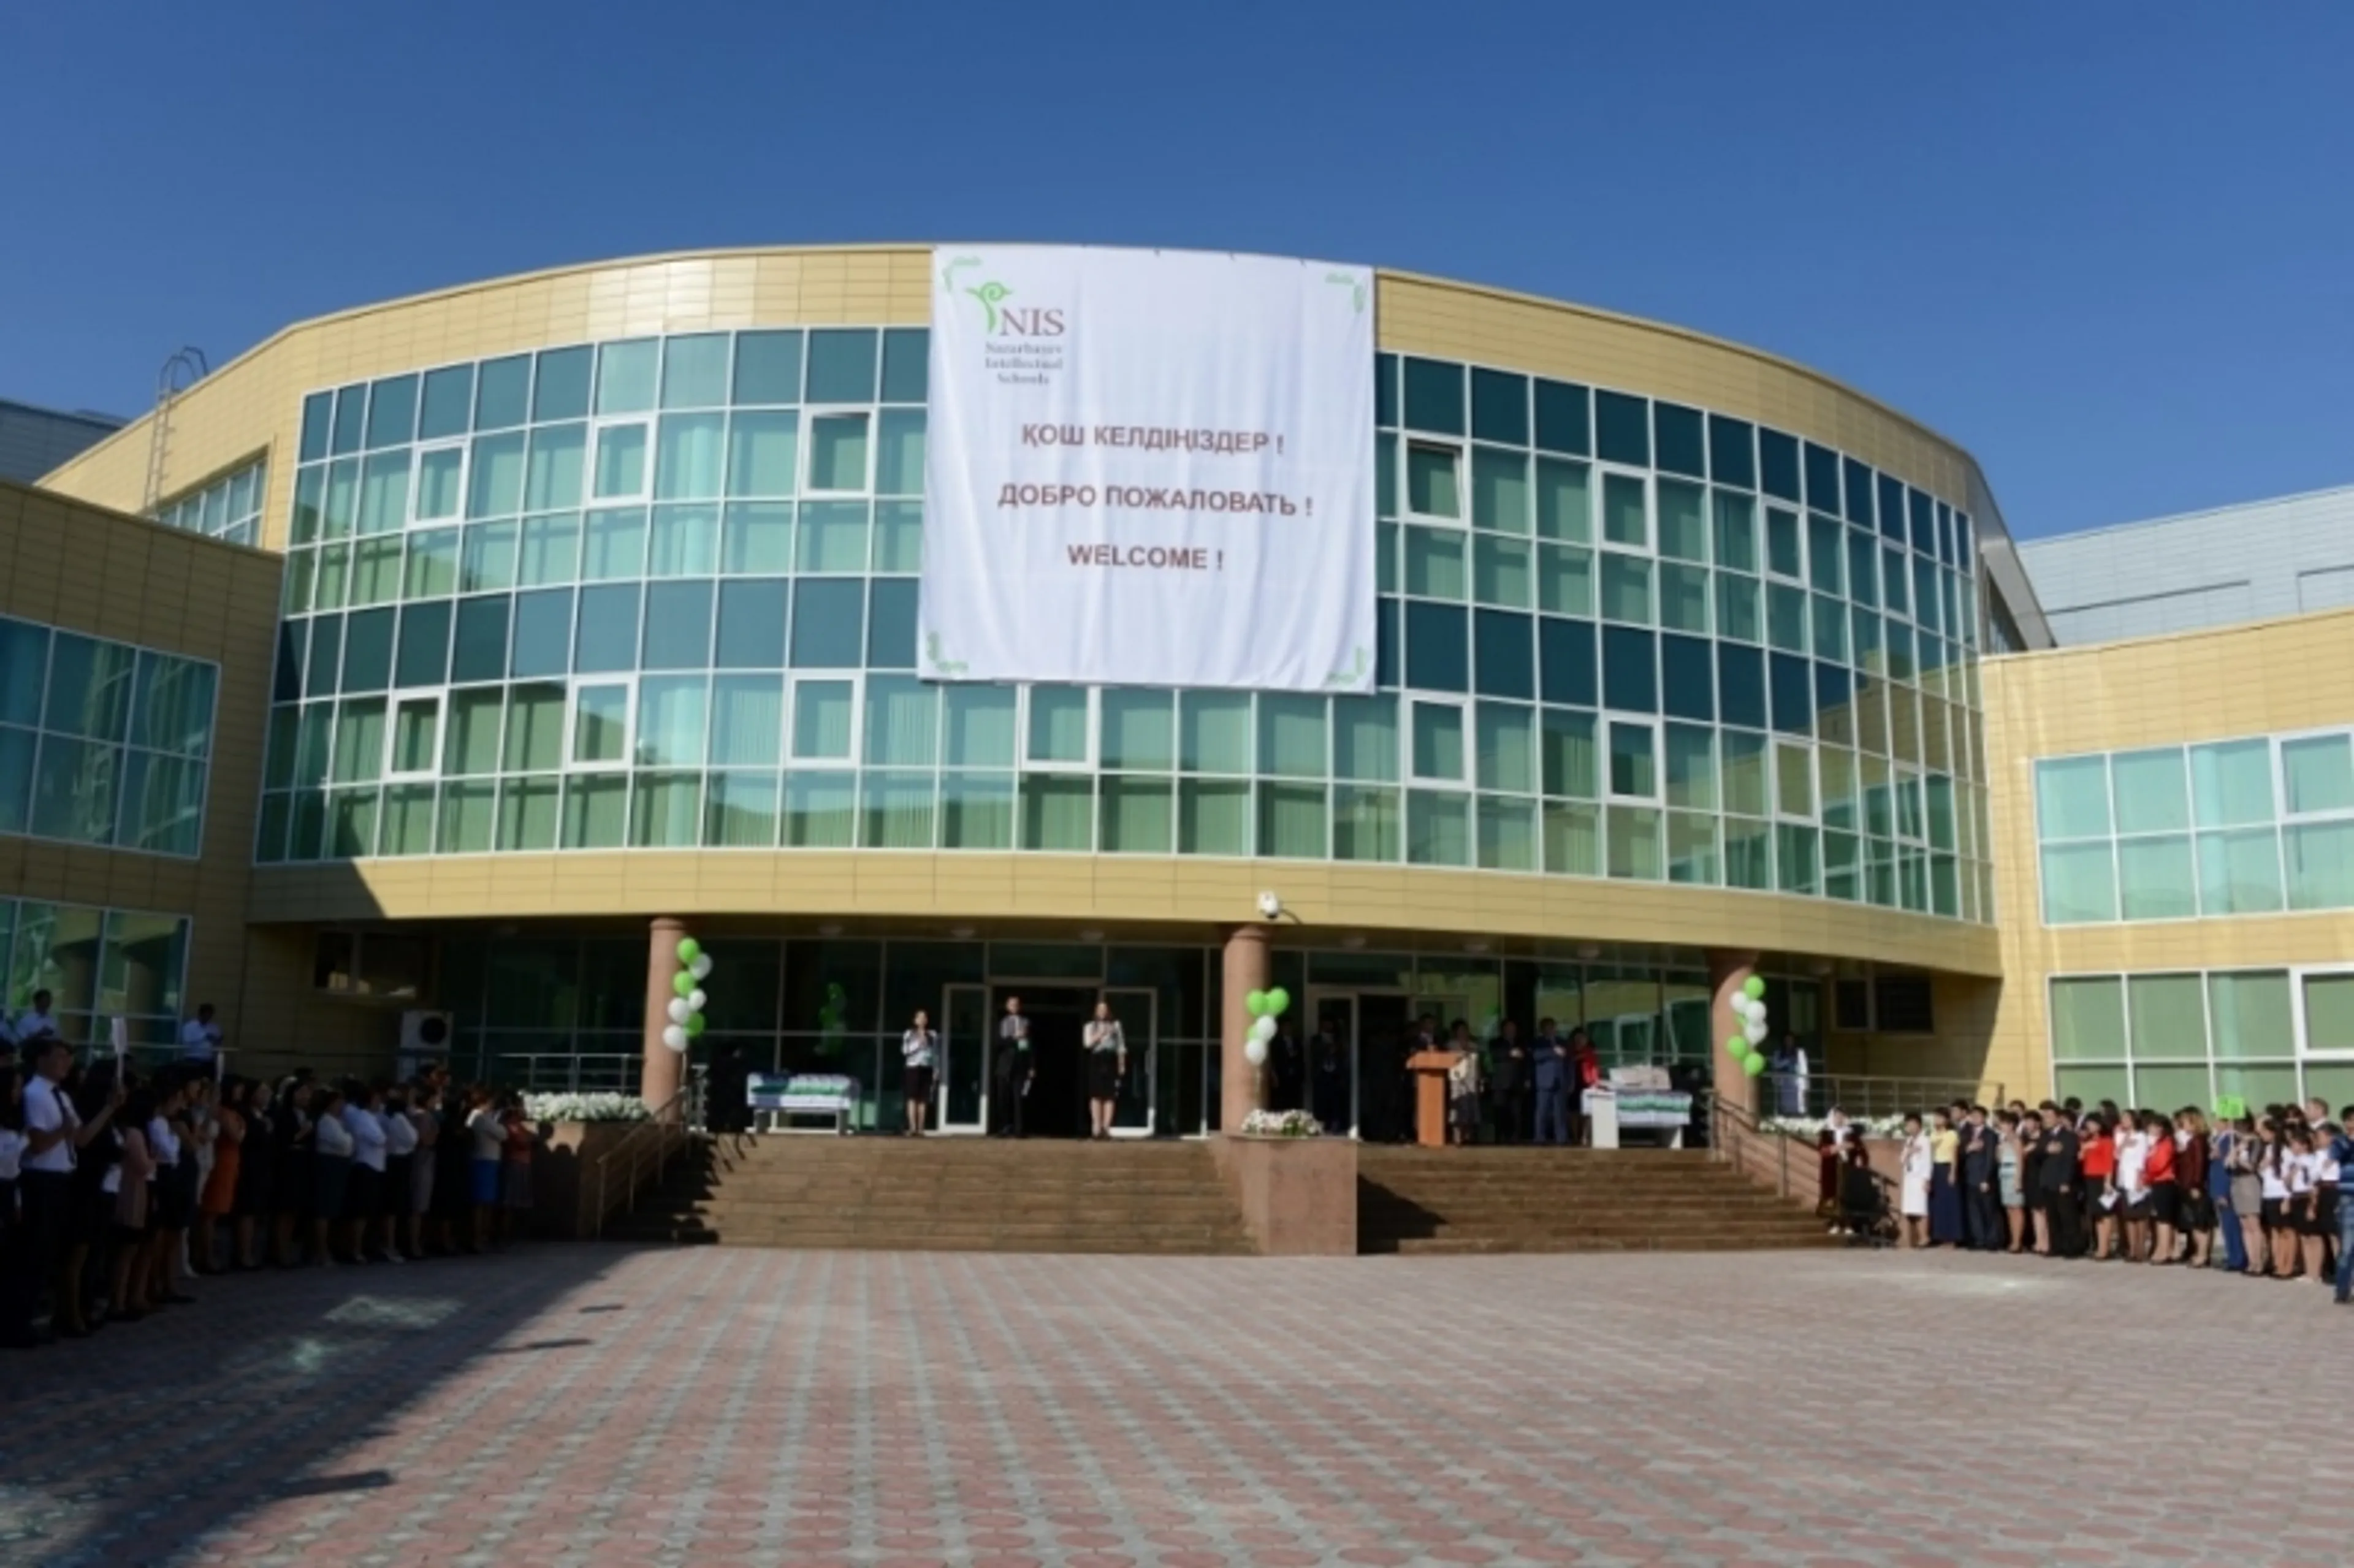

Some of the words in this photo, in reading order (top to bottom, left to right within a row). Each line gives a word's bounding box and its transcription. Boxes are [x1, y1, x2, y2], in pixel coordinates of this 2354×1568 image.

[999, 308, 1065, 337] NIS
[1021, 423, 1085, 448] ҚОШ
[997, 482, 1097, 509] ДОБРО
[1105, 484, 1297, 517] ПОЖАЛОВАТЬ
[1067, 543, 1208, 571] WELCOME
